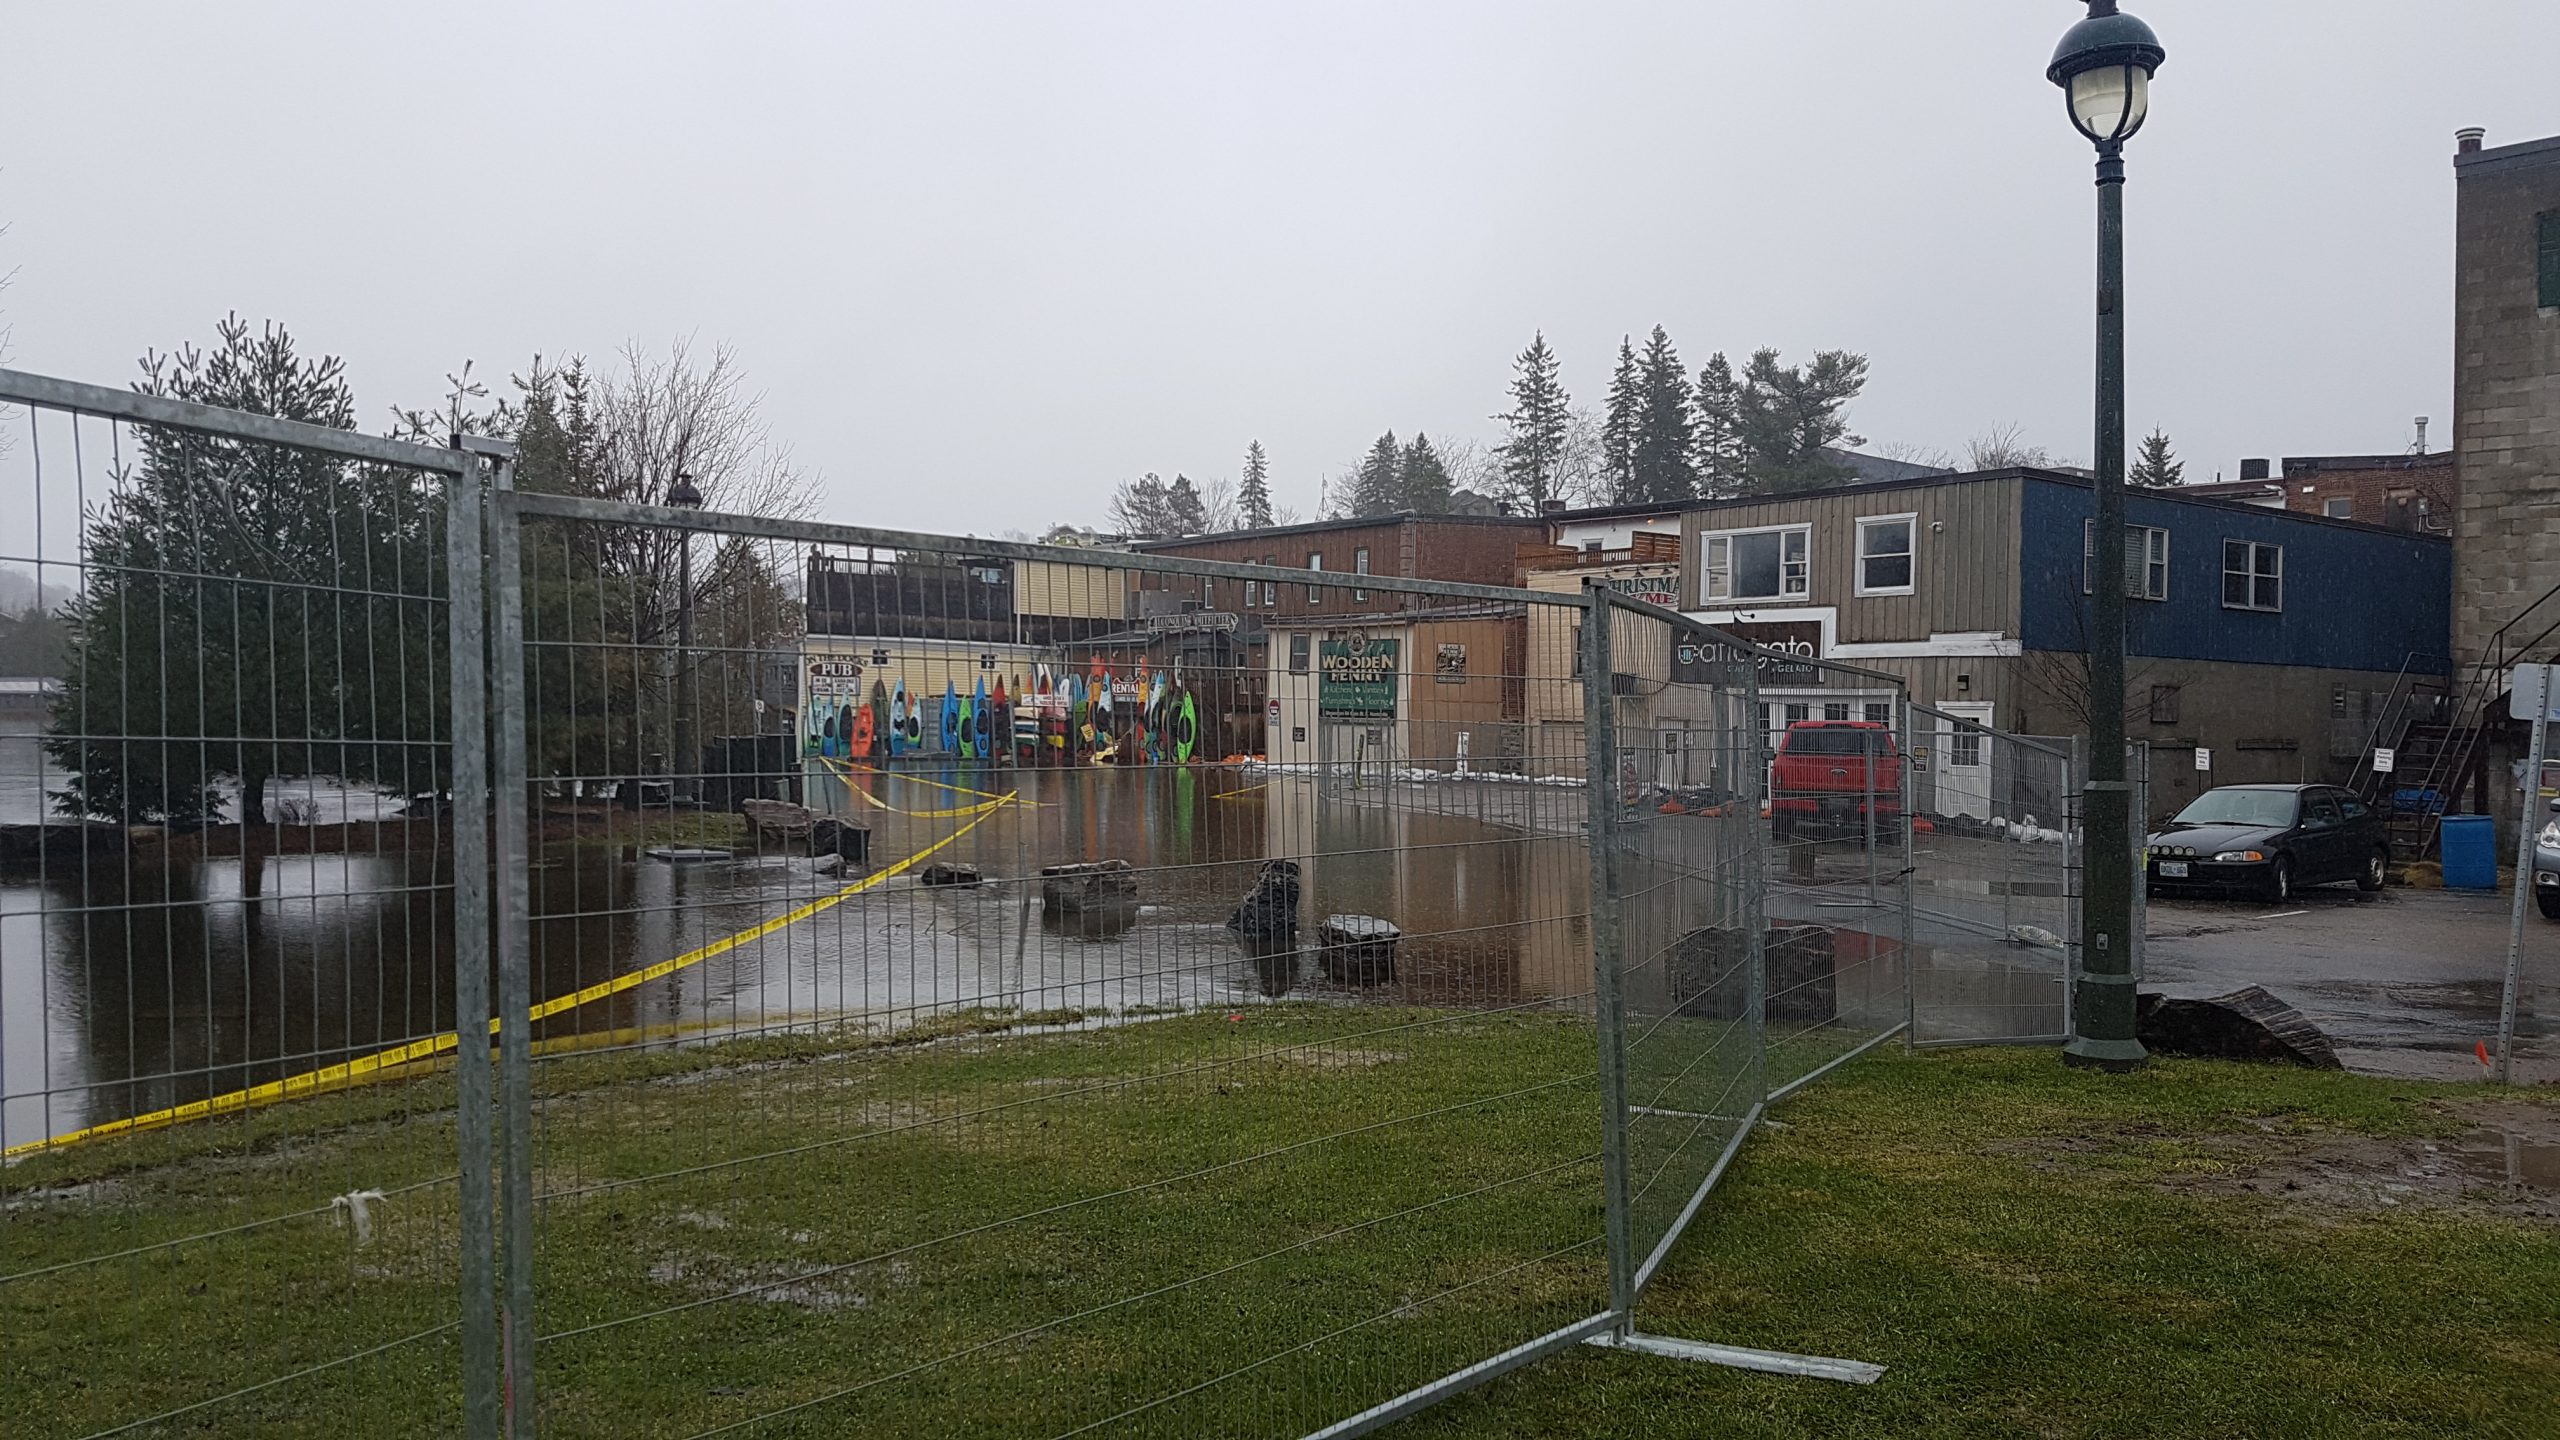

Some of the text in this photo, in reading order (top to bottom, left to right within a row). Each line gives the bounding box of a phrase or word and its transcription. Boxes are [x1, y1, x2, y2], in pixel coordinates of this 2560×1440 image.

[1322, 654, 1393, 669] WOODEN
[821, 663, 853, 676] PUB
[1331, 668, 1383, 681] PENNY
[1778, 664, 1813, 673] GELATO
